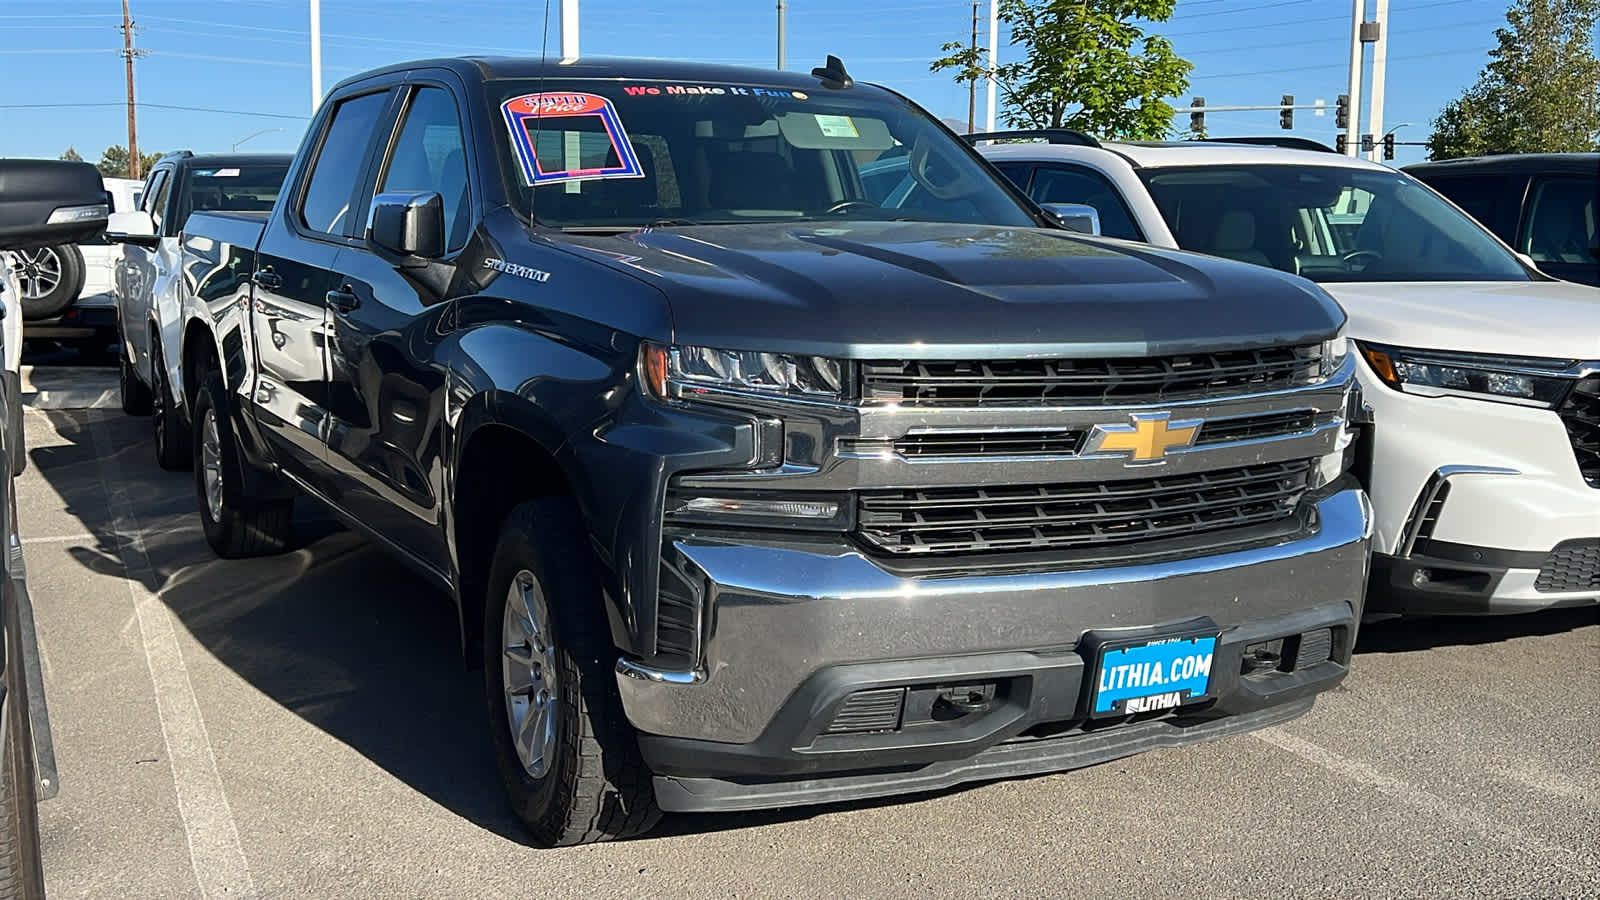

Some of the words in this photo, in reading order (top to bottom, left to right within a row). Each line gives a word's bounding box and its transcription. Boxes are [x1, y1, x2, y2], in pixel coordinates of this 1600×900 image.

[624, 86, 661, 96] We
[666, 86, 726, 95] Make
[730, 86, 749, 96] It
[752, 88, 792, 98] Fun
[482, 257, 551, 282] SILVERADO
[1098, 653, 1214, 693] LITHIA.COM
[1138, 691, 1182, 713] LITHIA
